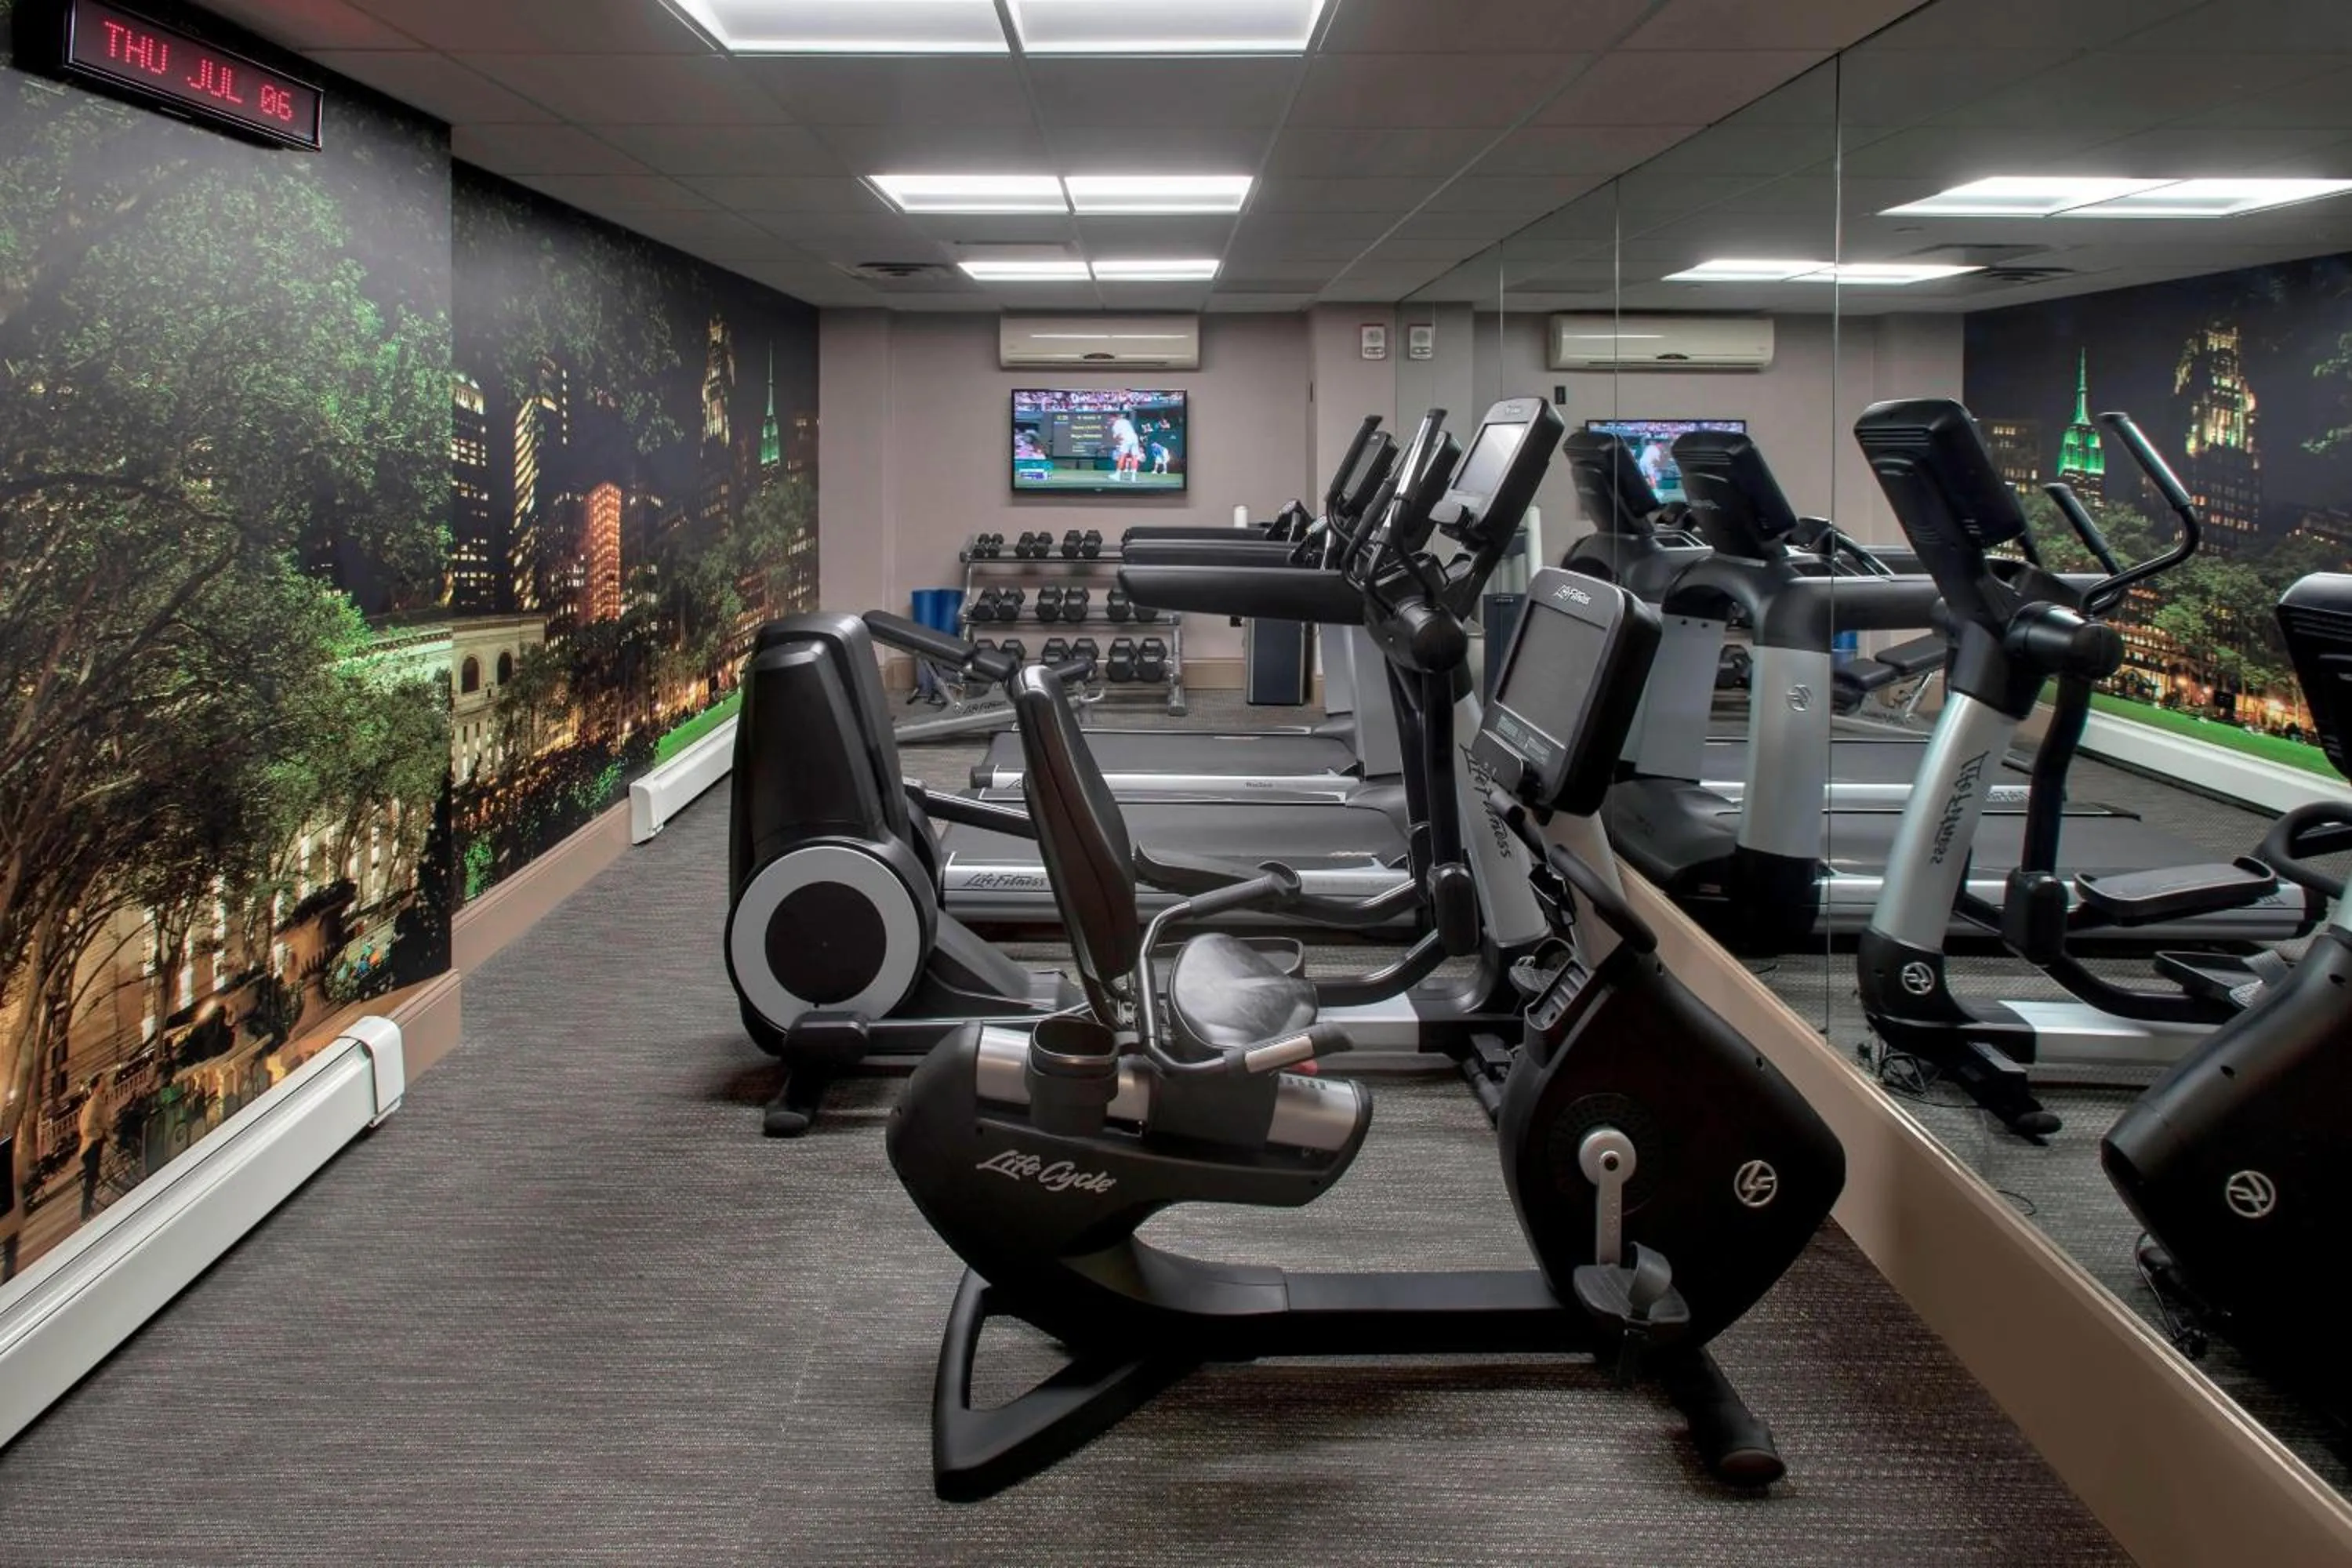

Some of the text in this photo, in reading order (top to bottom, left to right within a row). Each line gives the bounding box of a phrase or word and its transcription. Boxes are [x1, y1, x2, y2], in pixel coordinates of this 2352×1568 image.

[104, 21, 292, 121] THU JUL 06
[975, 1149, 1117, 1193] Life Cycle
